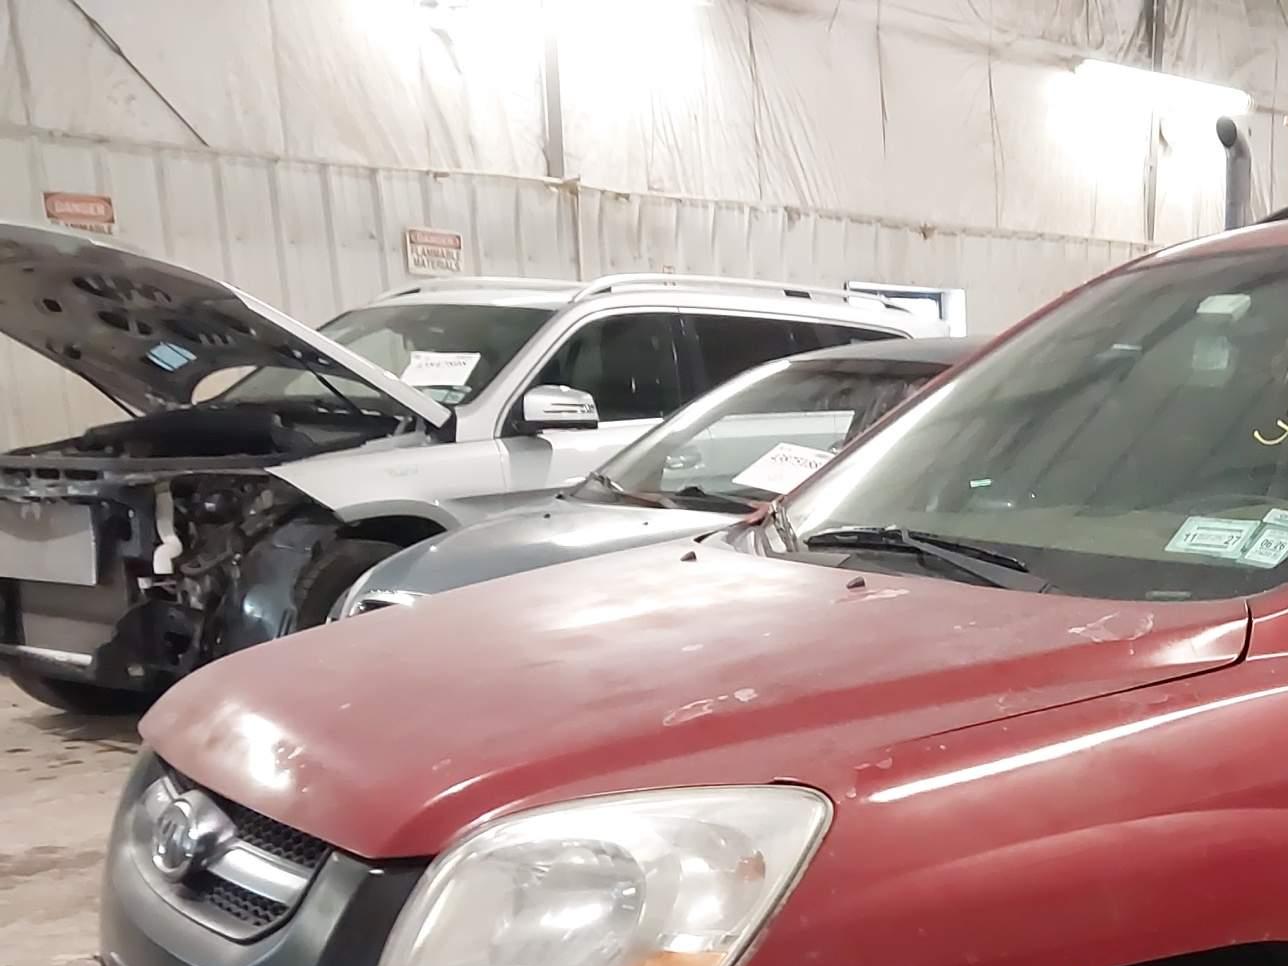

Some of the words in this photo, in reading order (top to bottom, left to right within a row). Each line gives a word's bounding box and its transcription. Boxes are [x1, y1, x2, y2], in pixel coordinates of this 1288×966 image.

[54, 200, 106, 216] DANGER
[410, 246, 461, 260] FLAMMABLE
[413, 257, 461, 271] MATERIALS
[1223, 535, 1242, 546] 27
